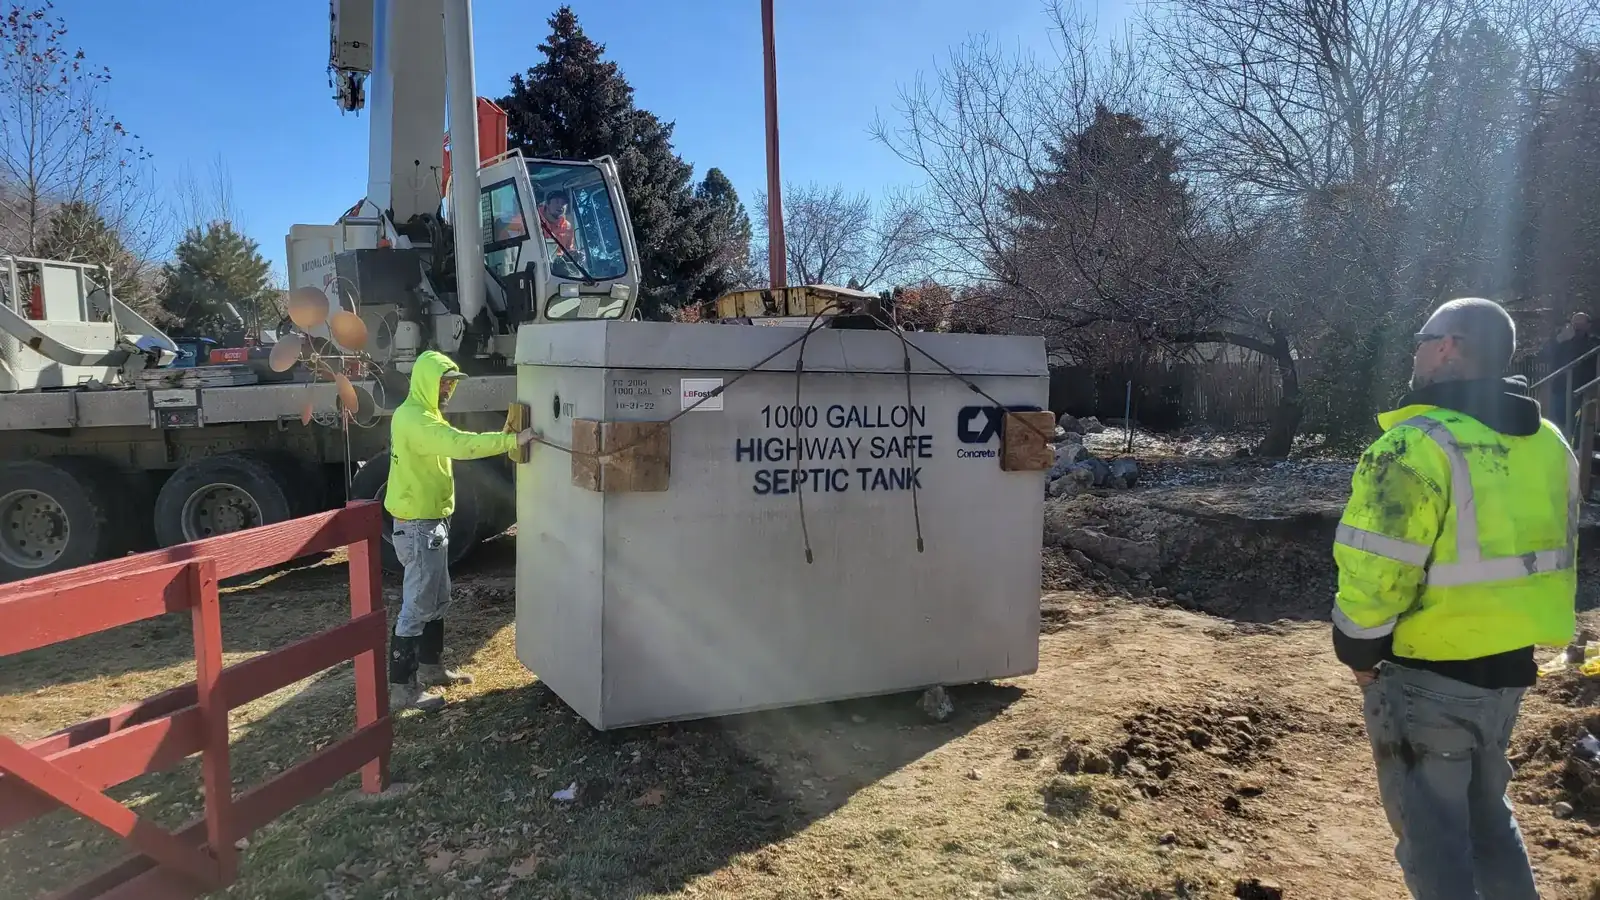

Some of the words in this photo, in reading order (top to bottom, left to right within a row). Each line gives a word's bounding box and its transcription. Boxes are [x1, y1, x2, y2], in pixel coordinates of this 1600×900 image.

[562, 402, 574, 417] OUT
[616, 402, 655, 410] 10-31-22
[761, 405, 818, 428] 1000
[826, 404, 925, 428] GALLON
[736, 436, 862, 462] HIGHWAY
[870, 435, 933, 460] SAFE
[956, 448, 996, 458] Concrete
[753, 469, 849, 494] SEPTIC
[856, 467, 922, 491] TANK
